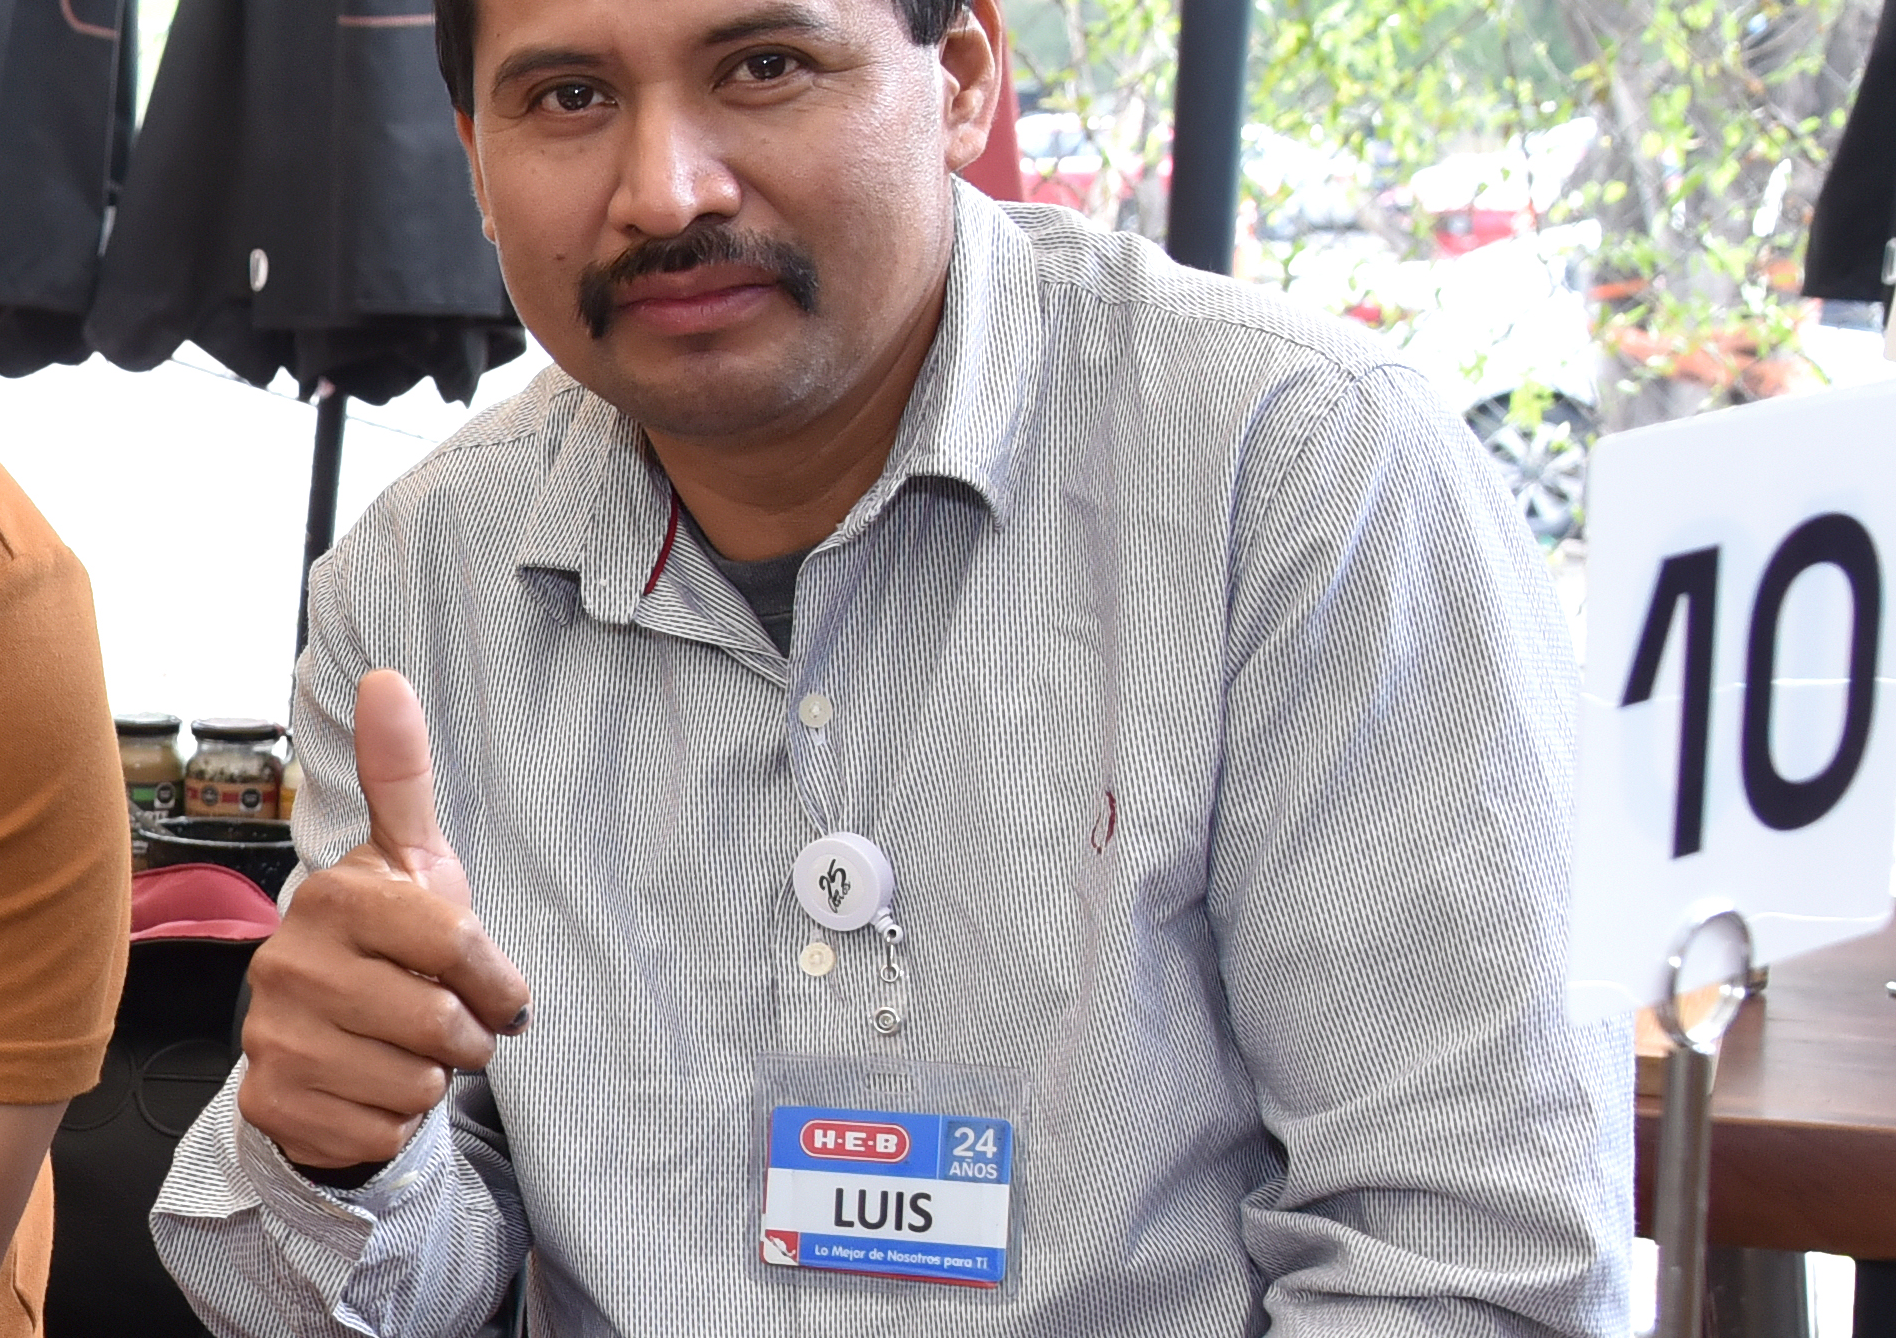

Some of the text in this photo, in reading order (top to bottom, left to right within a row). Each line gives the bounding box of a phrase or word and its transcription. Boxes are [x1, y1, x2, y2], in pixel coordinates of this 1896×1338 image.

[1617, 511, 1883, 861] 10
[952, 1126, 998, 1158] 24
[949, 1159, 998, 1179] AÑOS
[833, 1187, 933, 1234] LUIS
[814, 1244, 829, 1256] Lo
[831, 1245, 865, 1261] Mejor
[868, 1248, 885, 1260] de
[887, 1249, 941, 1265] Nosotros
[943, 1256, 973, 1269] para
